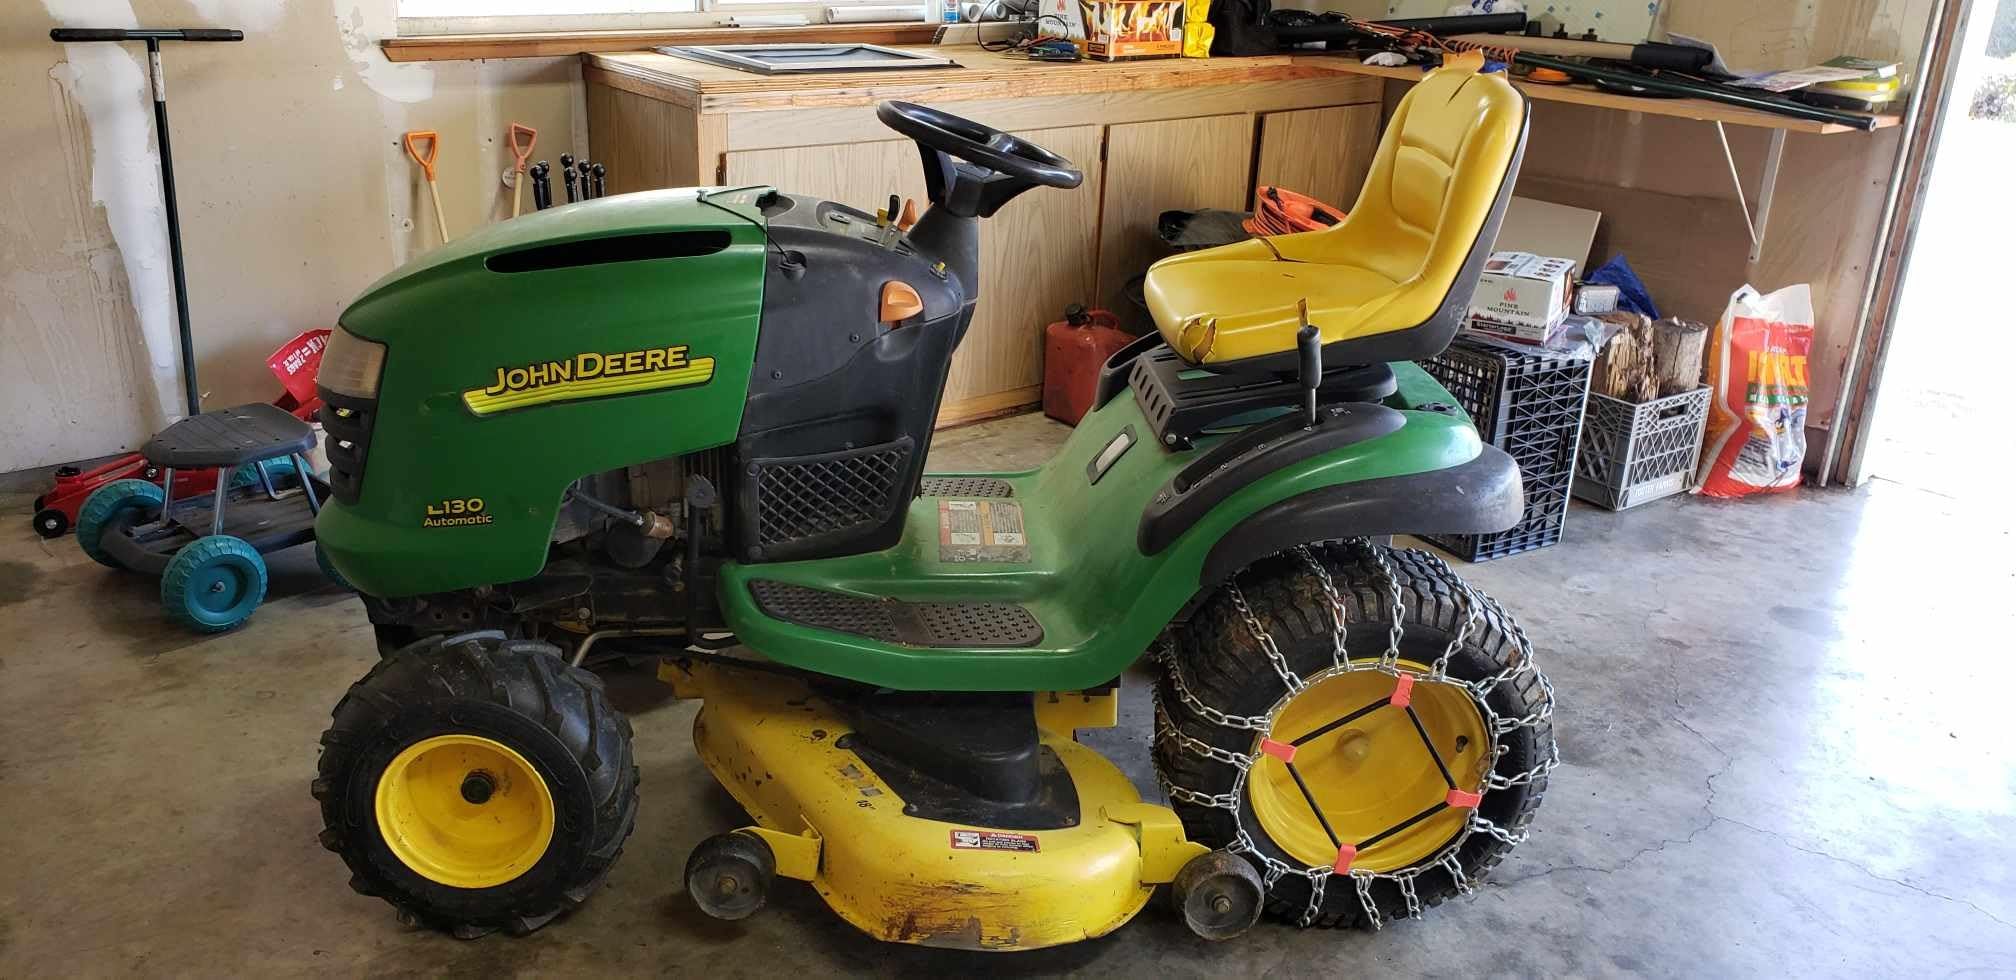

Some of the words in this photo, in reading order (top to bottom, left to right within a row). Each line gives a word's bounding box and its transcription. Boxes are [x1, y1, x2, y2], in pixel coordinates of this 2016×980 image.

[1487, 306, 1530, 317] MOUNTAIN
[1499, 302, 1519, 310] PINE
[486, 360, 572, 395] JOHN
[577, 346, 688, 378] DEERE
[427, 498, 484, 515] L130
[423, 515, 493, 527] Automatic
